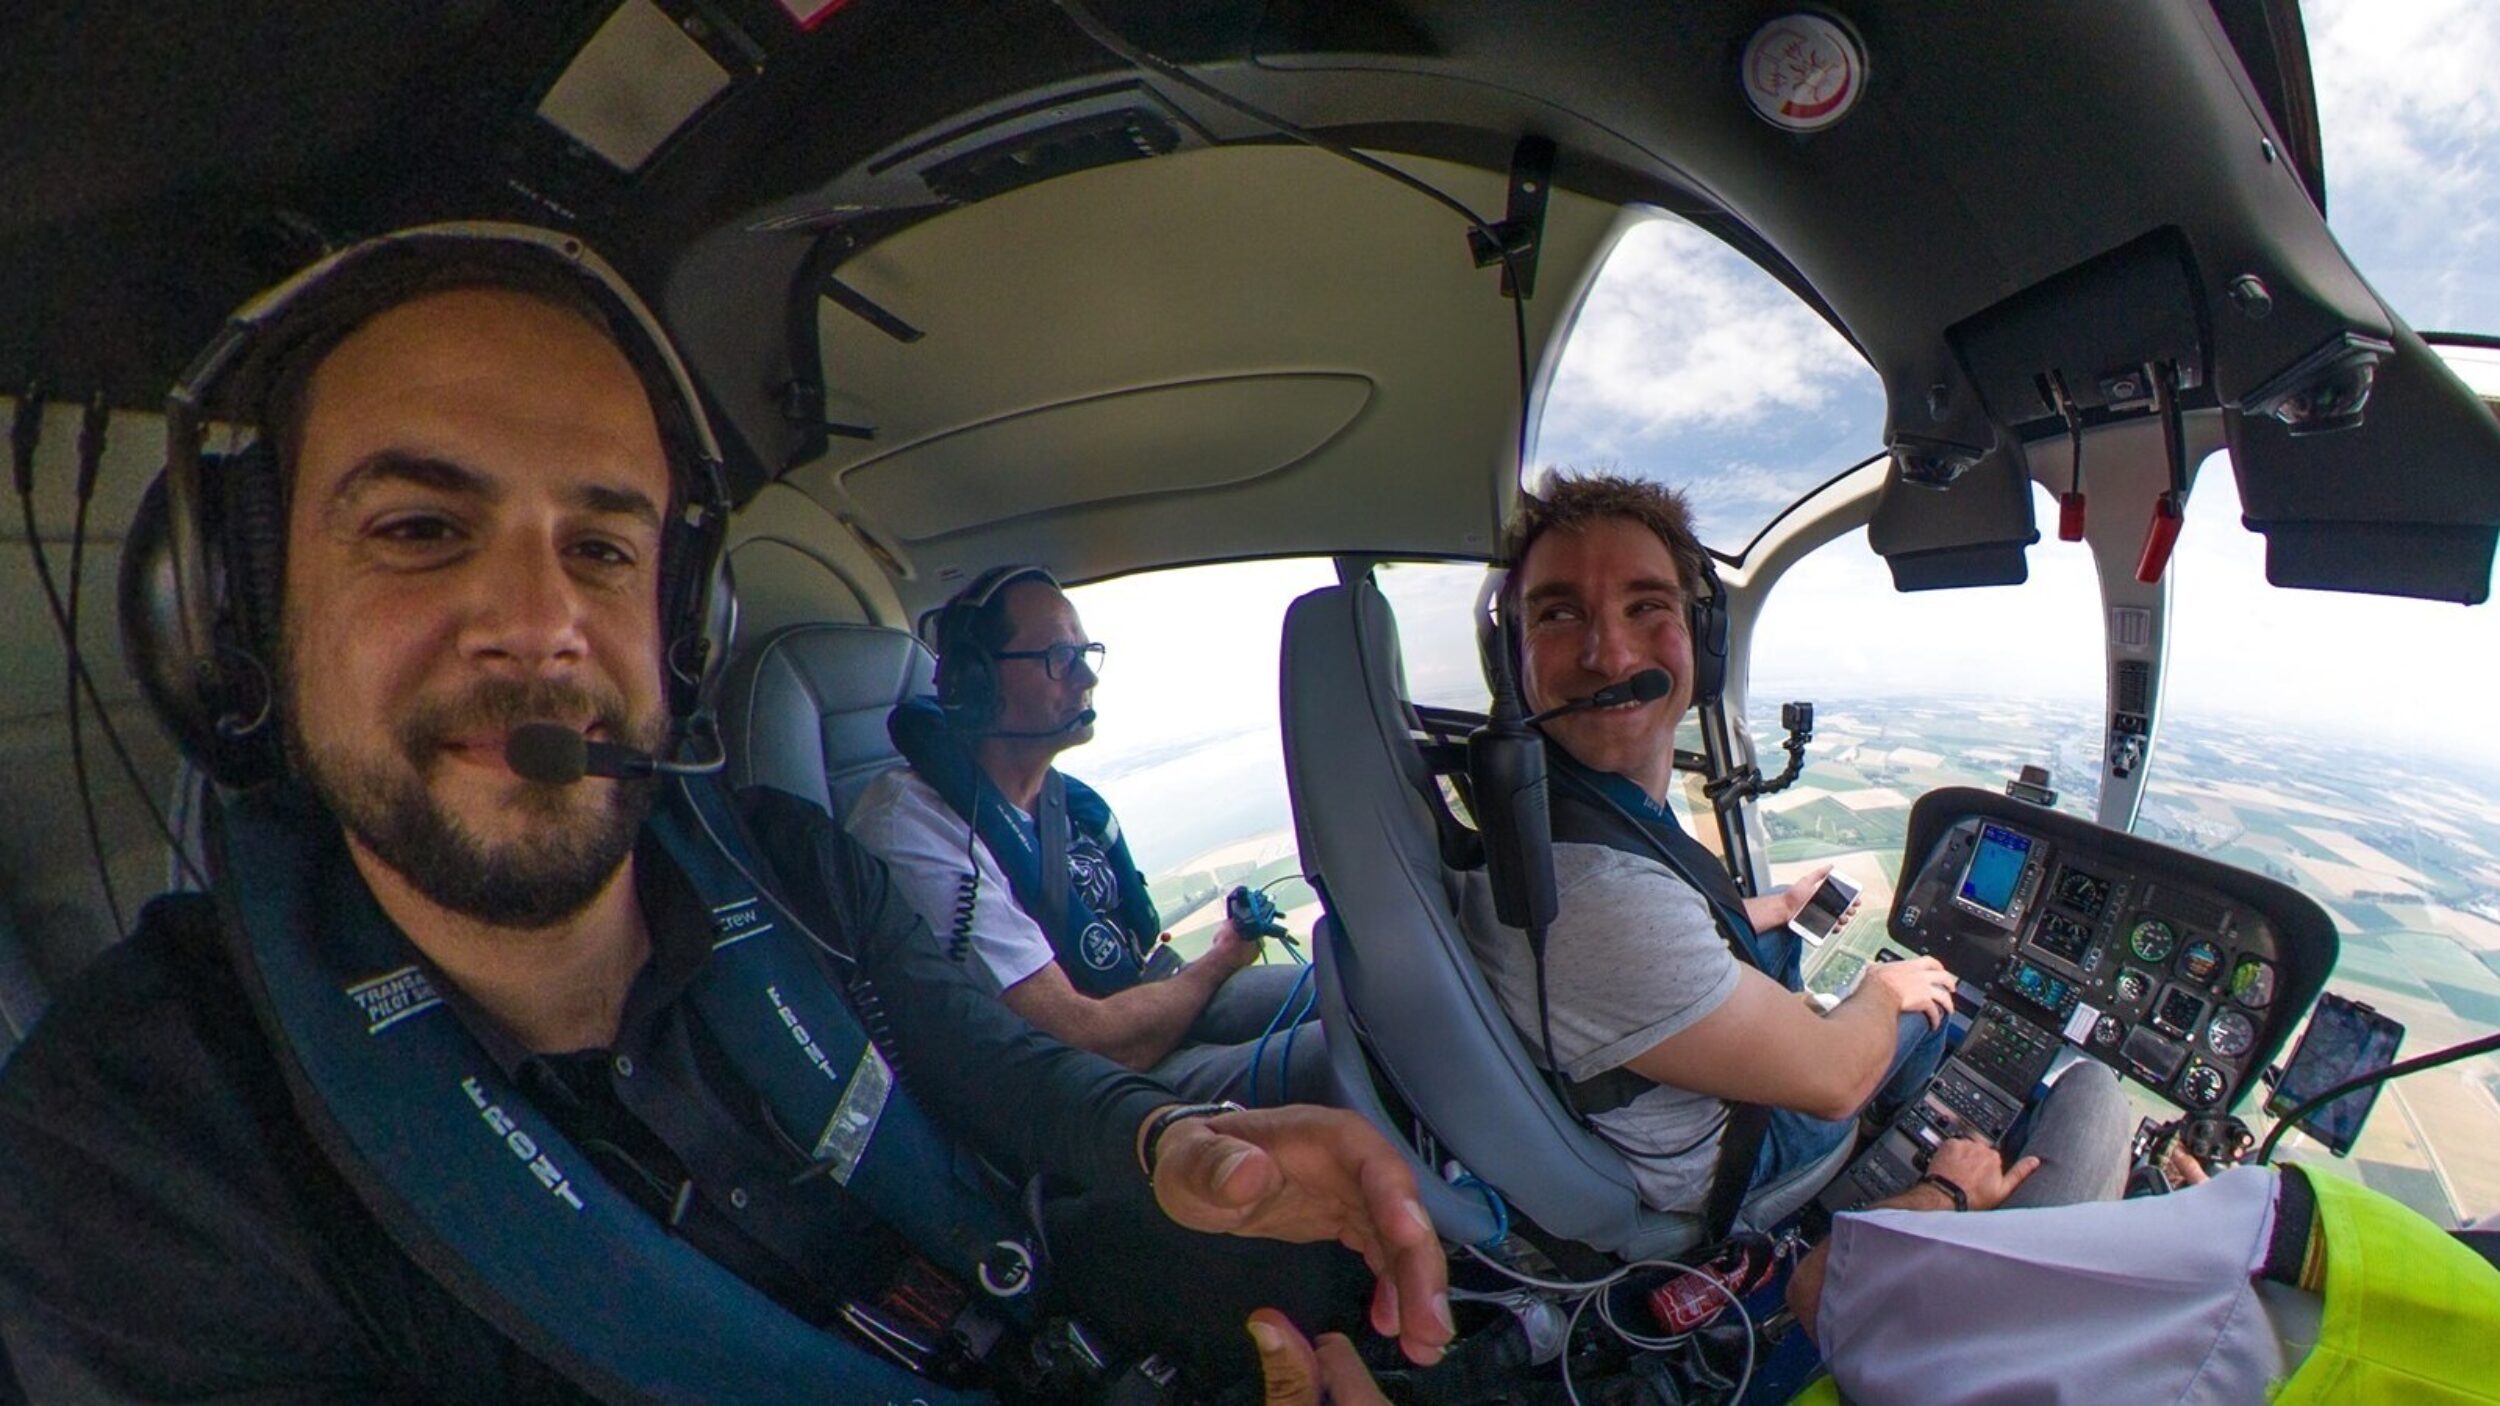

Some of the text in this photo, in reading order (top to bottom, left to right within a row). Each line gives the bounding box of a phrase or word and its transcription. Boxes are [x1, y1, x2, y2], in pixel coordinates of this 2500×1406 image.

[353, 973, 427, 1009] TRANSA
[367, 991, 410, 1022] PILOT
[766, 985, 838, 1081] FRONT
[461, 1075, 584, 1211] FRONT
